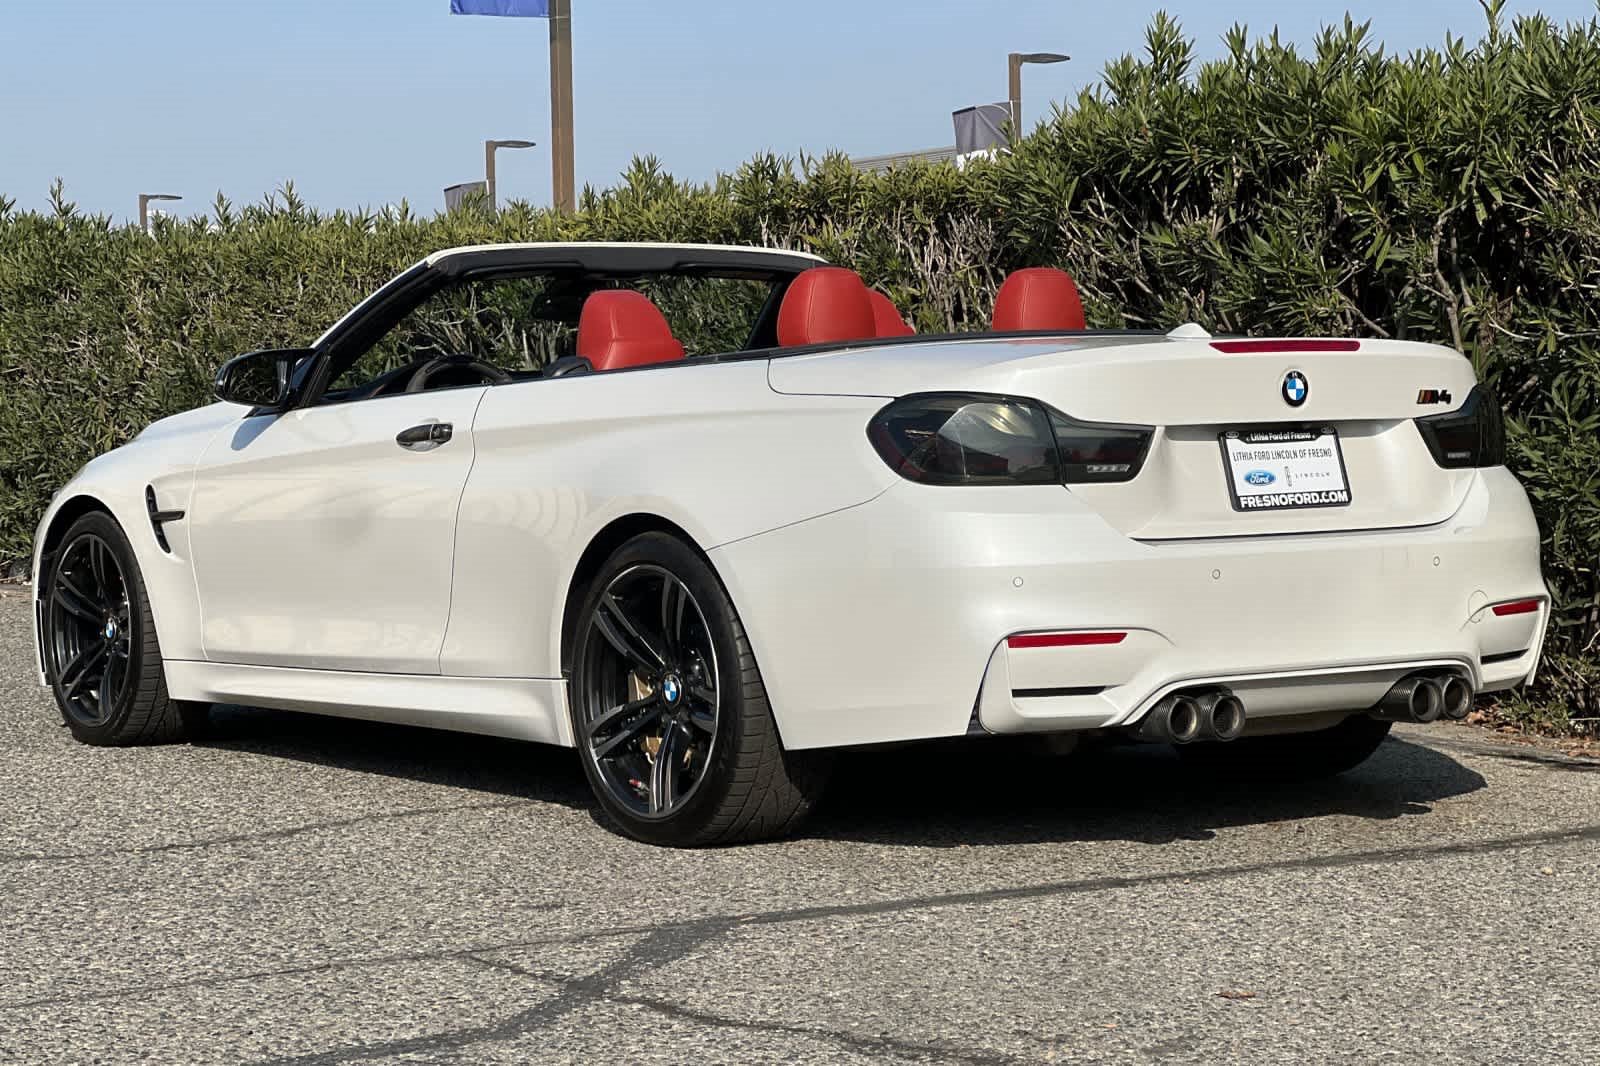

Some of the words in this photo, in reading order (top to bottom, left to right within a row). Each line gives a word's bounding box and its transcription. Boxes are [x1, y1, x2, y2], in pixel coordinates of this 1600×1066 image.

[1250, 432, 1269, 441] Lithia
[1269, 432, 1283, 441] Ford
[1290, 431, 1311, 440] Fresno
[1233, 451, 1253, 461] LITHIA
[1253, 450, 1270, 460] FORD
[1271, 448, 1298, 459] LINCOLN
[1299, 449, 1307, 458] OF
[1308, 447, 1332, 458] FRESNO
[1240, 490, 1348, 508] FRESNOFORD.COM
